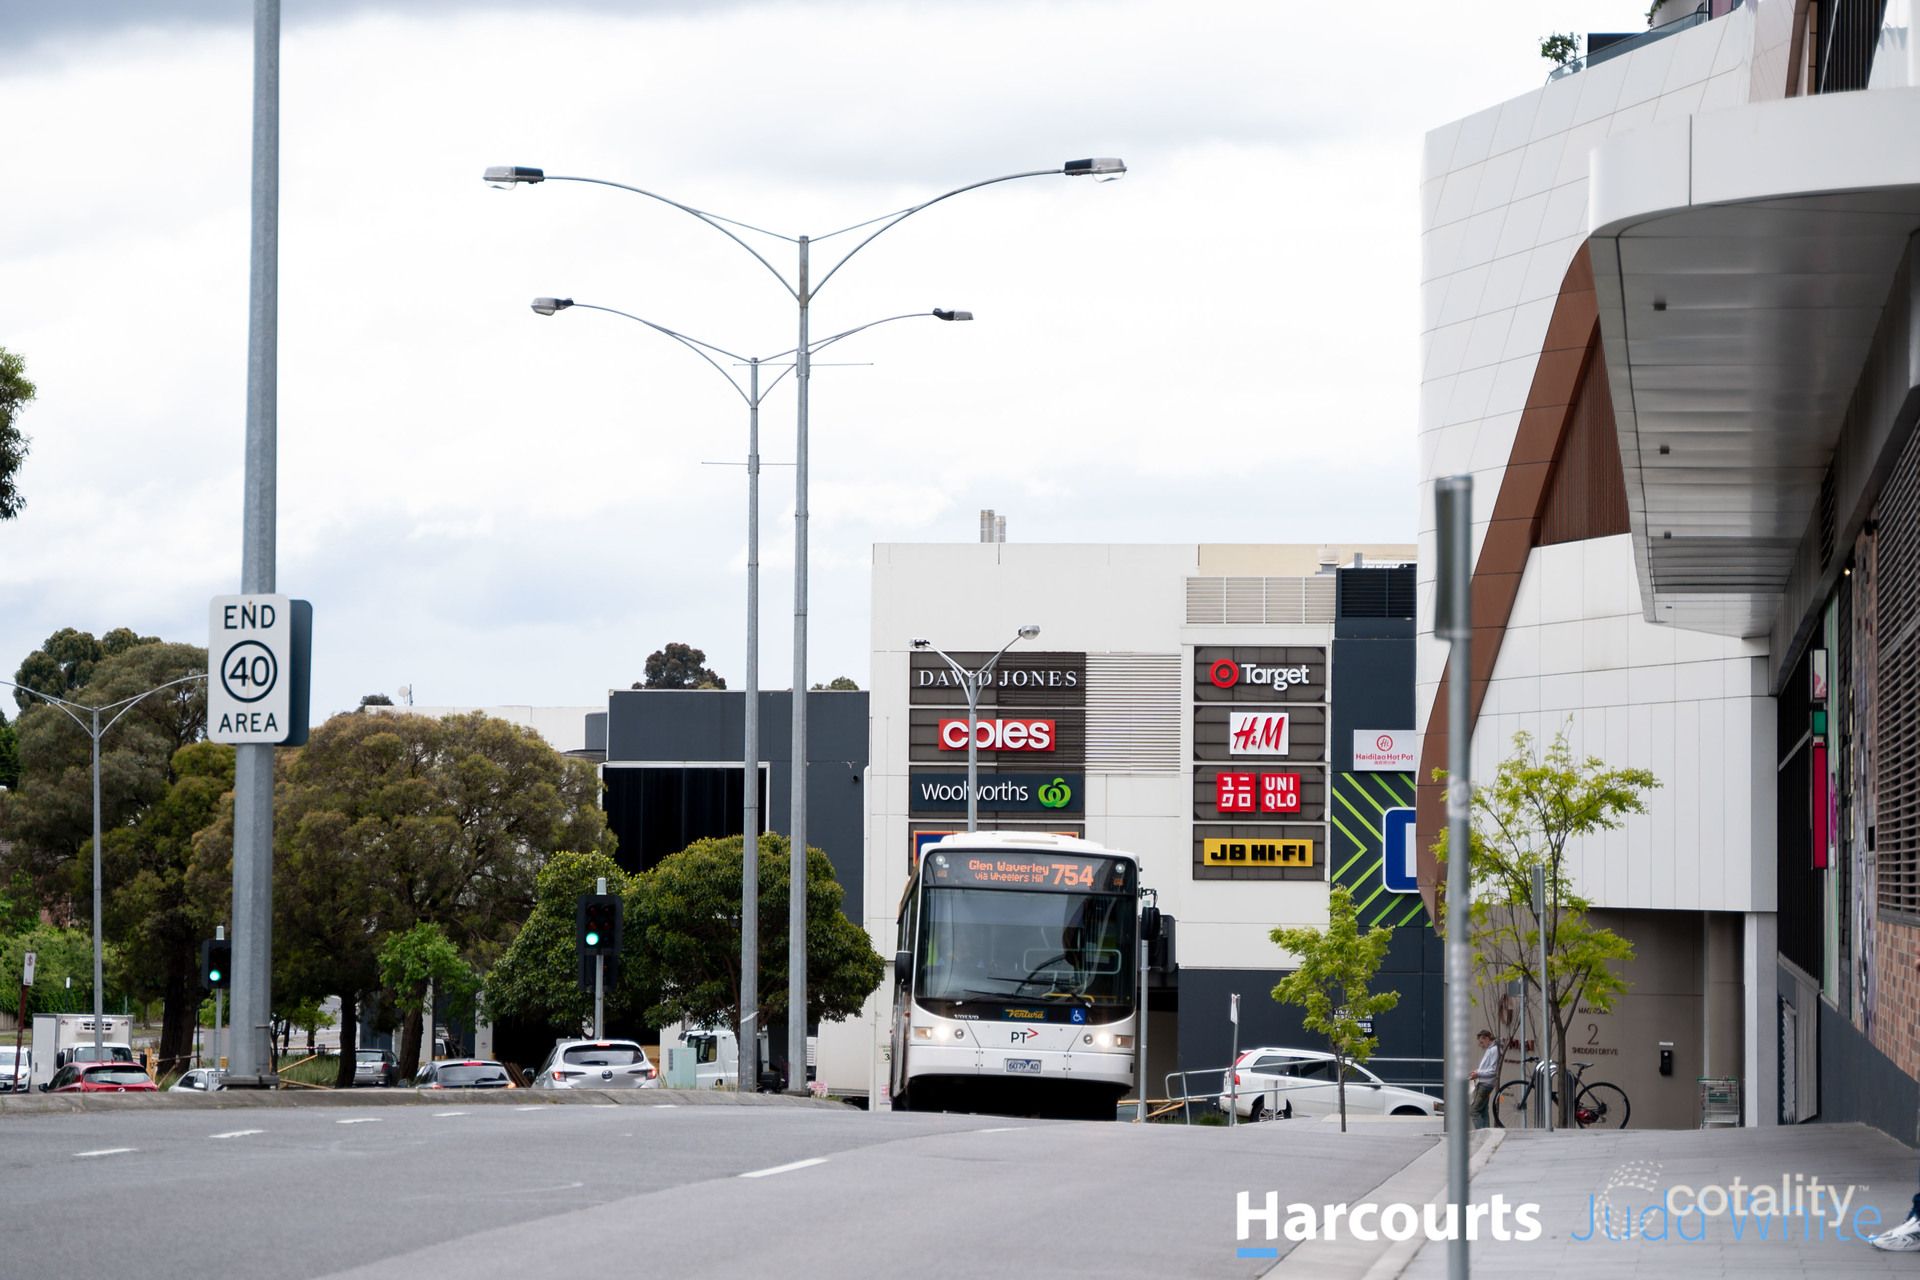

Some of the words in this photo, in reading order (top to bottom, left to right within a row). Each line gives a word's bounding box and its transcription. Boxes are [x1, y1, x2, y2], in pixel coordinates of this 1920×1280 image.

[224, 605, 276, 629] END
[228, 656, 270, 687] 40
[999, 670, 1078, 687] JONES
[1241, 663, 1310, 691] Target
[218, 712, 279, 733] AREA
[942, 719, 1051, 749] coles
[1233, 716, 1286, 752] H&M
[1265, 777, 1295, 791] UNI
[1265, 793, 1297, 810] QLO
[1210, 844, 1246, 860] JB
[968, 859, 993, 871] Glen
[997, 860, 1049, 876] Waverley
[1051, 863, 1094, 887] 754
[974, 872, 988, 881] via
[990, 872, 1030, 883] Wheelers
[1004, 1008, 1045, 1019] Ventura
[1011, 1031, 1028, 1044] PT
[1587, 1023, 1600, 1046] 2
